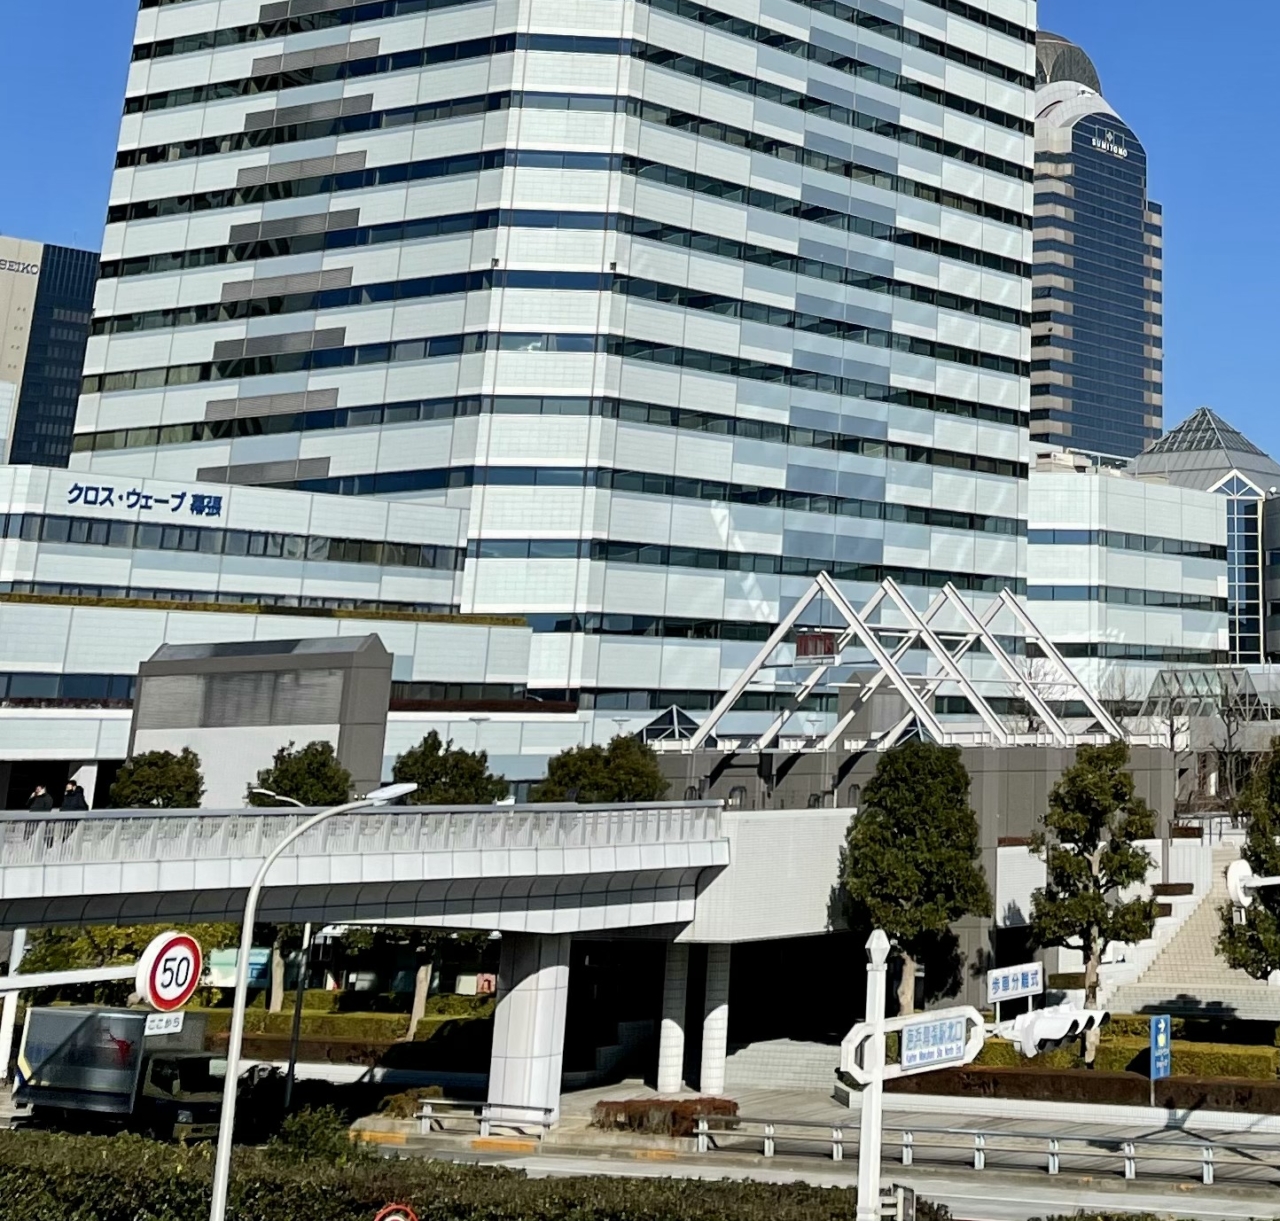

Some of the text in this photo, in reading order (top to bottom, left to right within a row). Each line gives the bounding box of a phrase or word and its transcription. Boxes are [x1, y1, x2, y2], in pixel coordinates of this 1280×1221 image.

[1091, 137, 1129, 158] SUMITOMO
[0, 258, 40, 275] SEIKO
[160, 956, 191, 989] 50
[991, 969, 1040, 996] 歩車分離式
[147, 1016, 181, 1031] ここから
